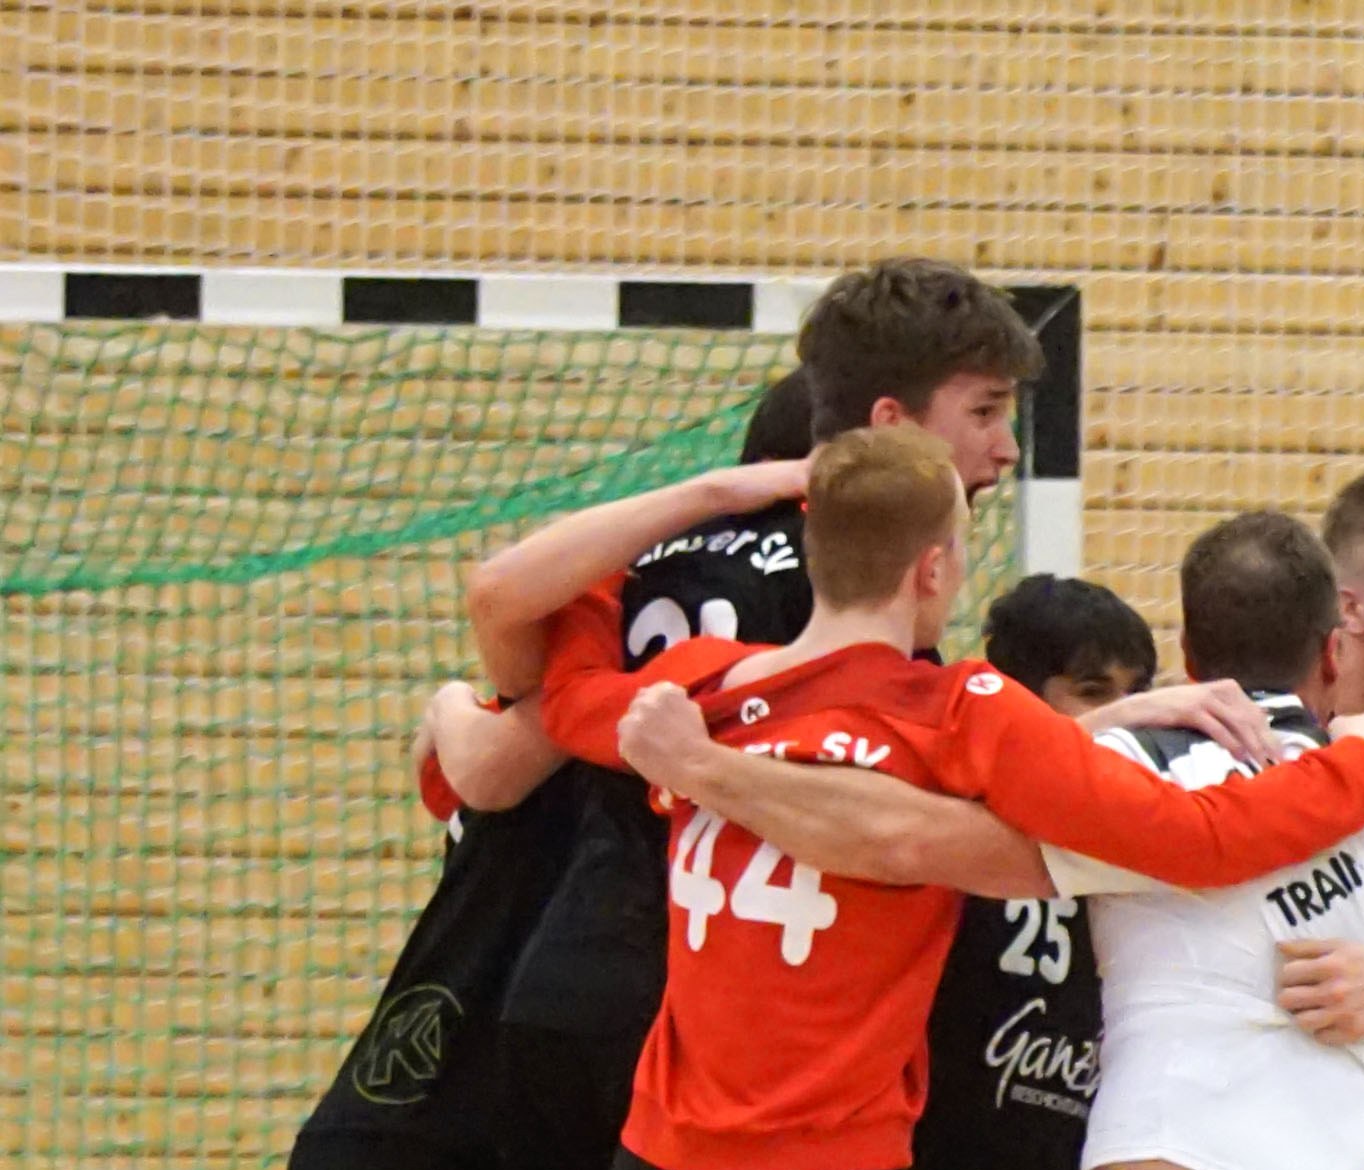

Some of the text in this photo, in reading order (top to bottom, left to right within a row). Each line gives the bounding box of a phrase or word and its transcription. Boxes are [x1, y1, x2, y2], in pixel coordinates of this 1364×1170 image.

[816, 731, 891, 769] SV
[669, 808, 838, 967] 44
[999, 897, 1079, 985] 25
